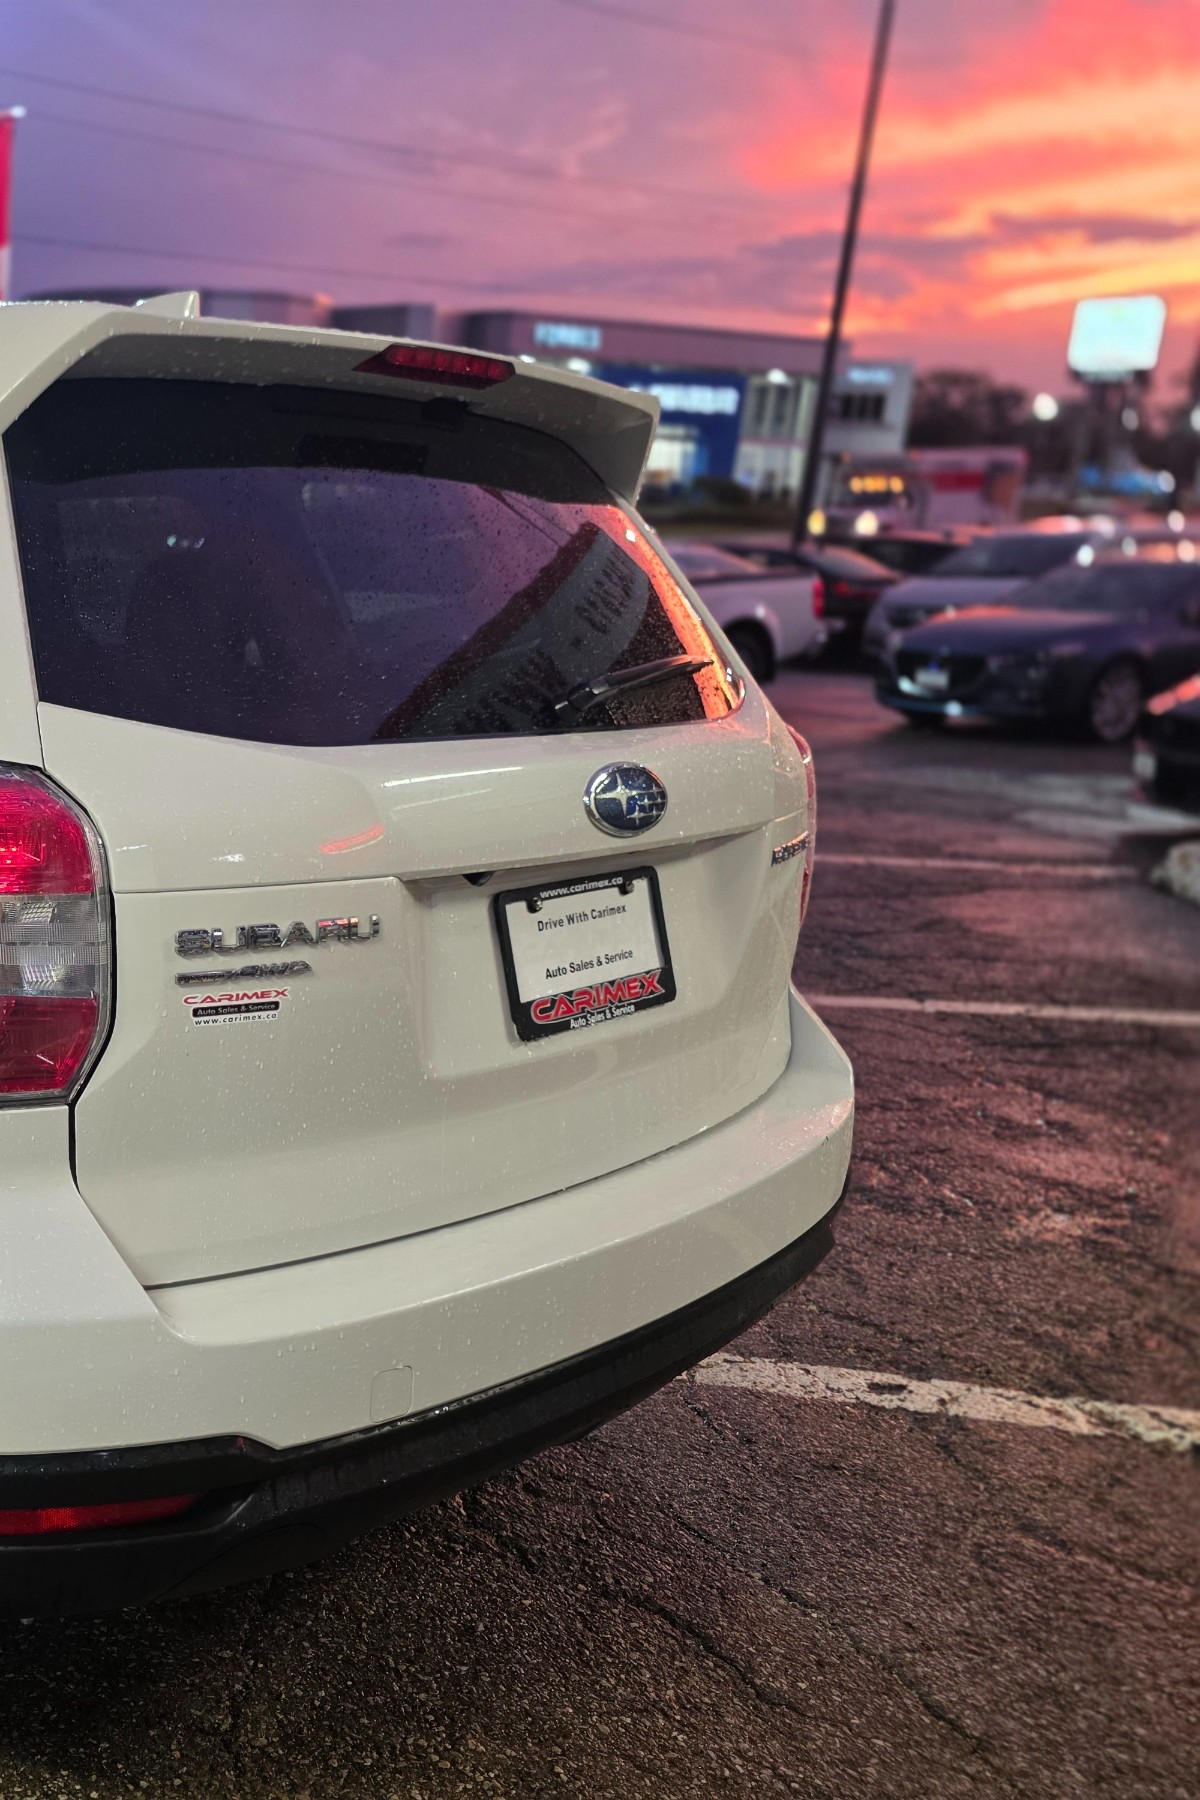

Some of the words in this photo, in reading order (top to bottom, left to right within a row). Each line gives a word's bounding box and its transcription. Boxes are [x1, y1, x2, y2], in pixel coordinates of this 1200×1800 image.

[540, 876, 623, 899] www.carimex.ca
[537, 914, 564, 932] Drive
[566, 910, 589, 926] With
[591, 904, 627, 920] Carimex
[175, 914, 380, 956] SUBARU
[545, 966, 567, 980] Auto
[569, 960, 594, 973] Sales
[596, 956, 603, 967] &
[604, 949, 634, 965] Service
[183, 988, 289, 1005] CARIMEX
[196, 1008, 216, 1016] Auto
[218, 1006, 238, 1014] Sales
[248, 1003, 276, 1012] Service
[531, 970, 663, 1023] CARIMEX
[194, 1013, 277, 1026] www.carimex.ca
[570, 1017, 587, 1029] Auto
[587, 1012, 605, 1027] Sales
[612, 1002, 636, 1018] Service
